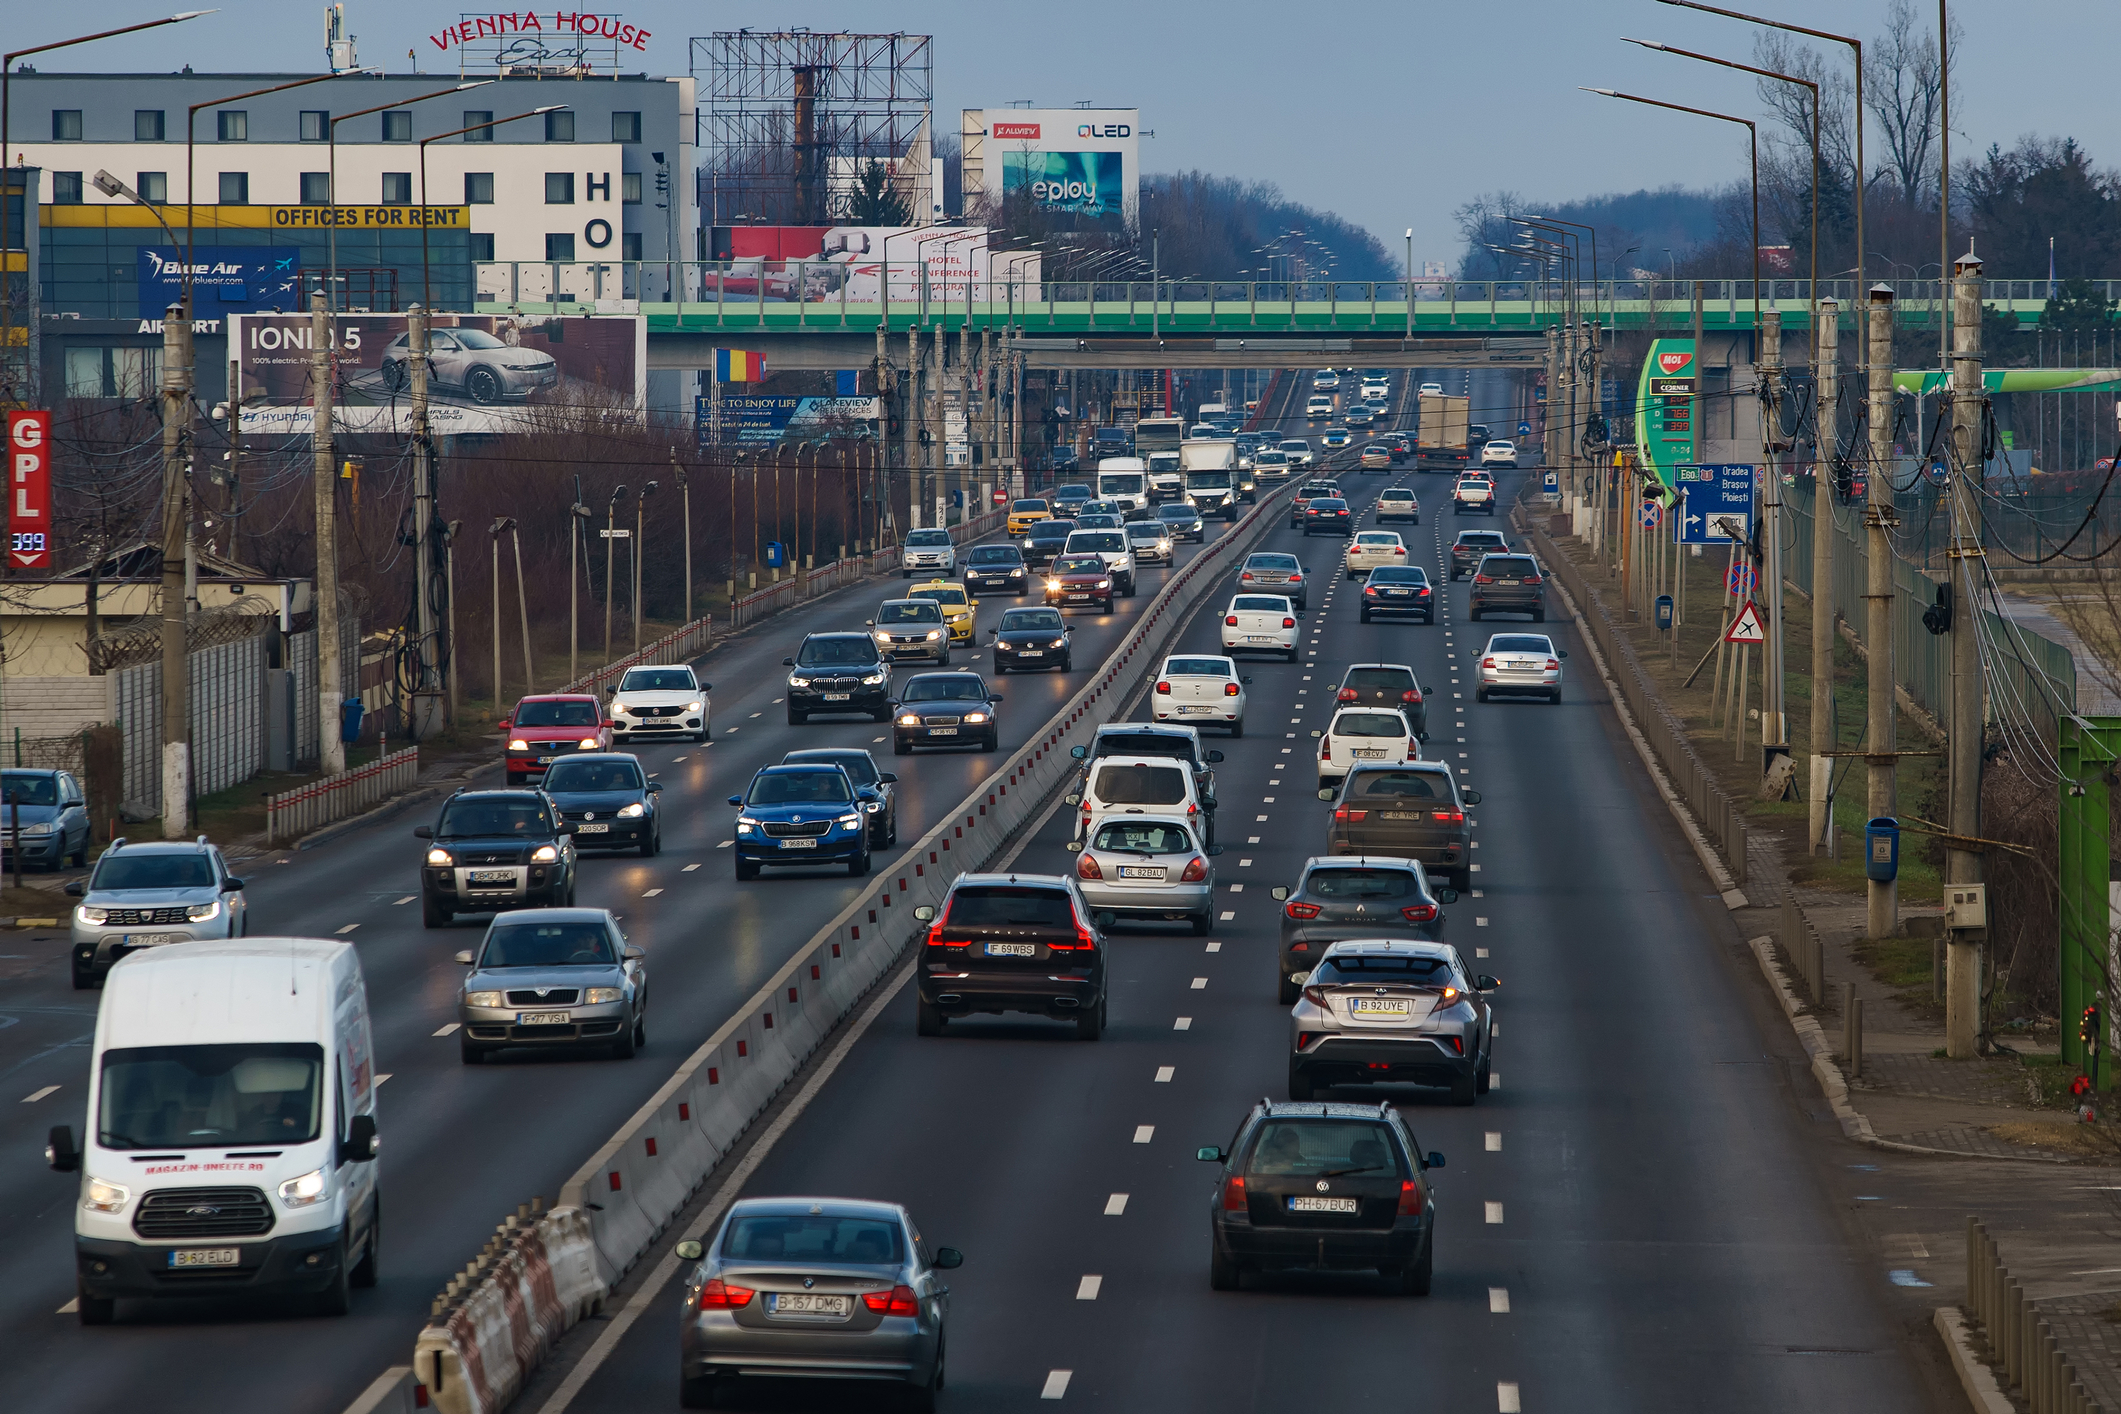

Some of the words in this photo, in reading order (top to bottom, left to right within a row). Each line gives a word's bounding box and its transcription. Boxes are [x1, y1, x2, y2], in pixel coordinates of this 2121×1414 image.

[430, 11, 542, 51] VIENNA
[556, 11, 652, 51] HOUSE
[1005, 127, 1037, 135] ALLVIEW
[1078, 124, 1131, 139] QLED
[275, 208, 358, 226] OFFICES
[364, 208, 404, 225] FOR
[409, 208, 460, 225] RENT
[911, 232, 945, 242] VIENNA
[211, 262, 243, 274] Air
[163, 276, 243, 286] wwwfyblueair.com
[137, 320, 220, 334] AIRRT
[251, 327, 335, 350] IONI
[344, 327, 361, 350] 5
[272, 356, 299, 364] electric.
[1663, 355, 1682, 365] MOL
[728, 399, 743, 408] TO
[745, 399, 775, 410] ENJOY
[778, 399, 796, 408] LIFE
[820, 399, 872, 407] LAKEVIEW
[1722, 466, 1749, 476] Oradea
[1722, 479, 1749, 491] Brașov
[1722, 492, 1749, 503] Ploiești
[1125, 868, 1135, 877] GL
[990, 944, 998, 953] IF
[1361, 1001, 1368, 1010] B
[549, 1014, 566, 1023] VSA
[177, 1253, 186, 1265] B
[190, 1252, 205, 1264] 62
[208, 1251, 233, 1264] ELD
[778, 1296, 787, 1309] B
[792, 1296, 812, 1309] 157
[815, 1297, 843, 1310] DMG
